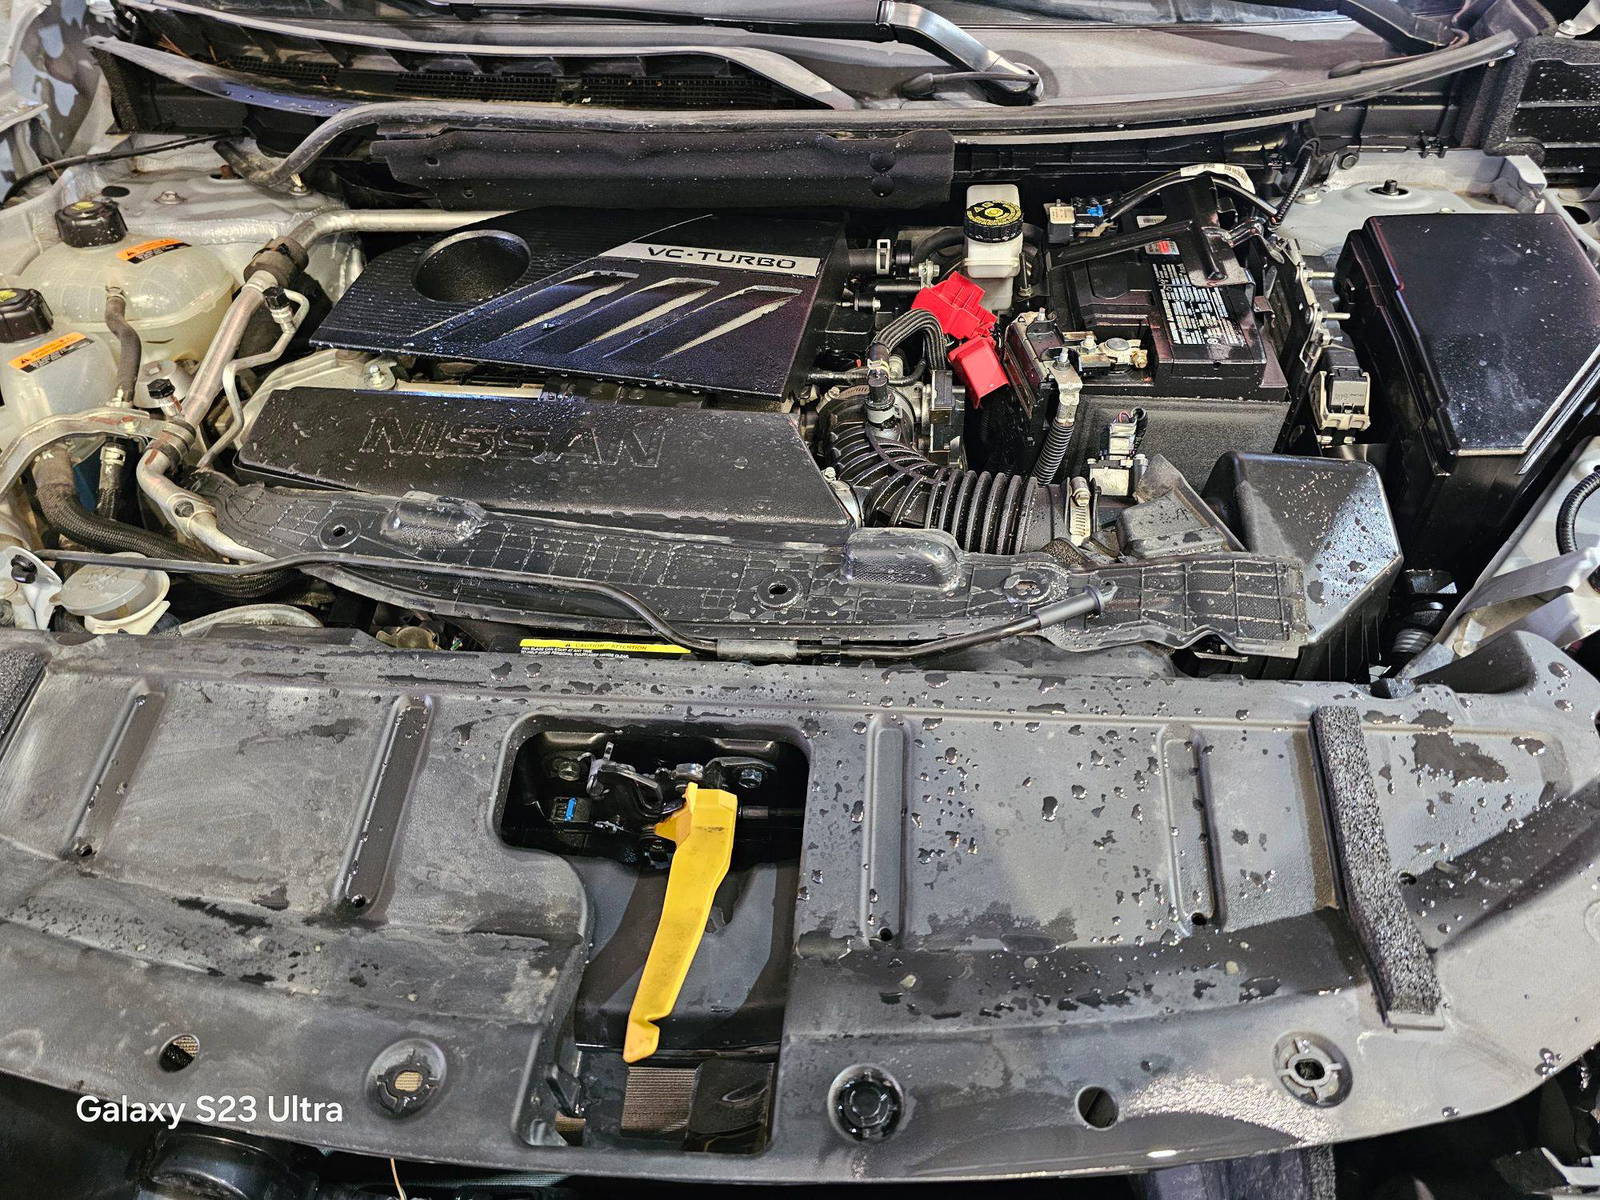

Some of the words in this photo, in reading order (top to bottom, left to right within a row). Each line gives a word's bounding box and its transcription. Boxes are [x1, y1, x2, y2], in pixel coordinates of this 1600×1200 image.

[647, 246, 797, 270] VC-TURBO
[358, 414, 667, 469] NISSAN
[610, 643, 648, 651] ATTENTION
